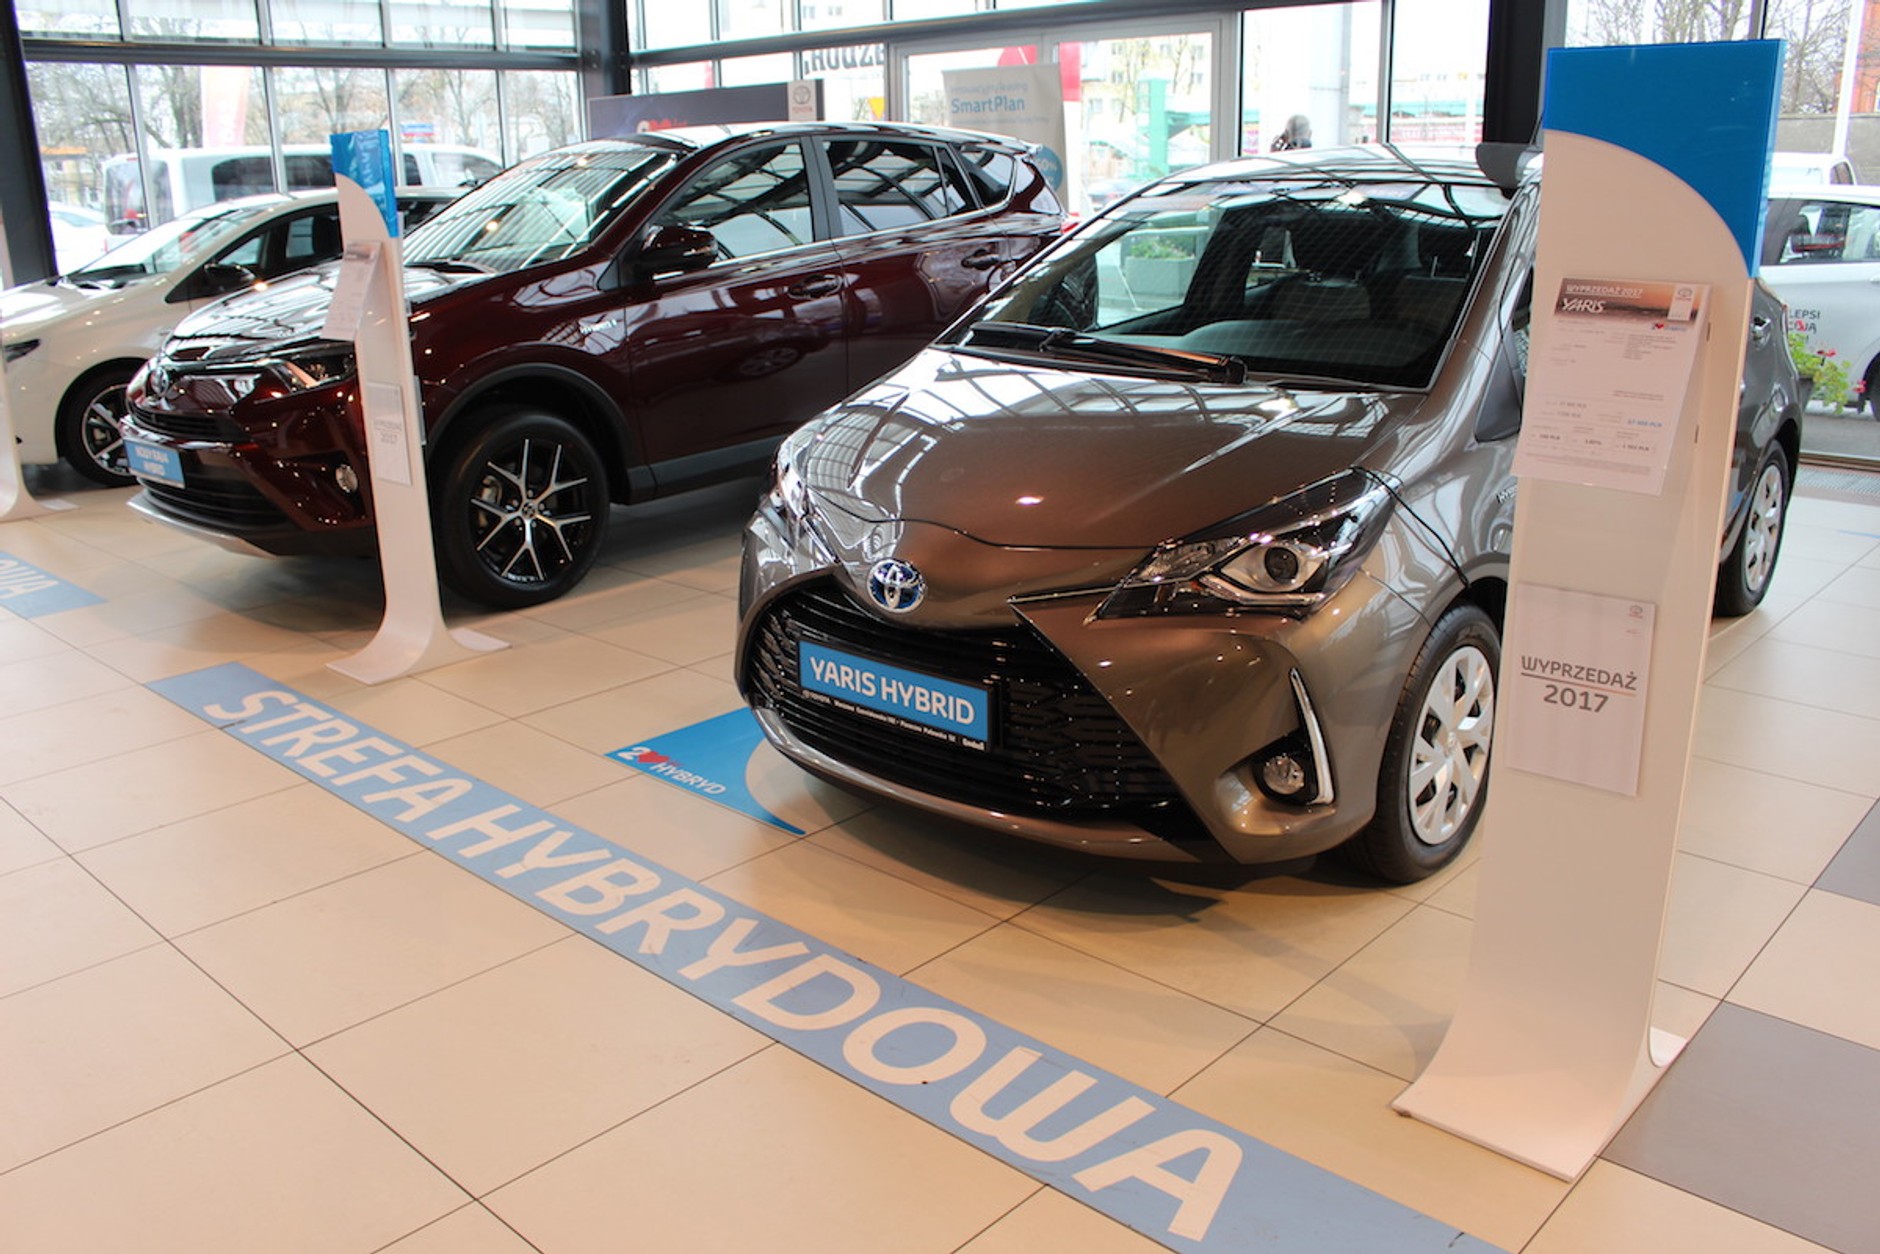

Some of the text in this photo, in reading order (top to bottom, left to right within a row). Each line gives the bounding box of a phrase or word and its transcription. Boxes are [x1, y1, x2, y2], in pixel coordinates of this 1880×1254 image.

[951, 95, 1025, 114] SmartPlan
[1562, 298, 1607, 313] YARIS
[1622, 287, 1644, 297] 2017
[1521, 655, 1638, 691] WYPRZEDAŻ
[810, 656, 877, 697] YARIS
[880, 677, 975, 725] HYBRID
[1543, 684, 1609, 713] 2017
[650, 762, 726, 794] HYBRYD
[203, 690, 1243, 1242] STREFA HYBRYDOWA
